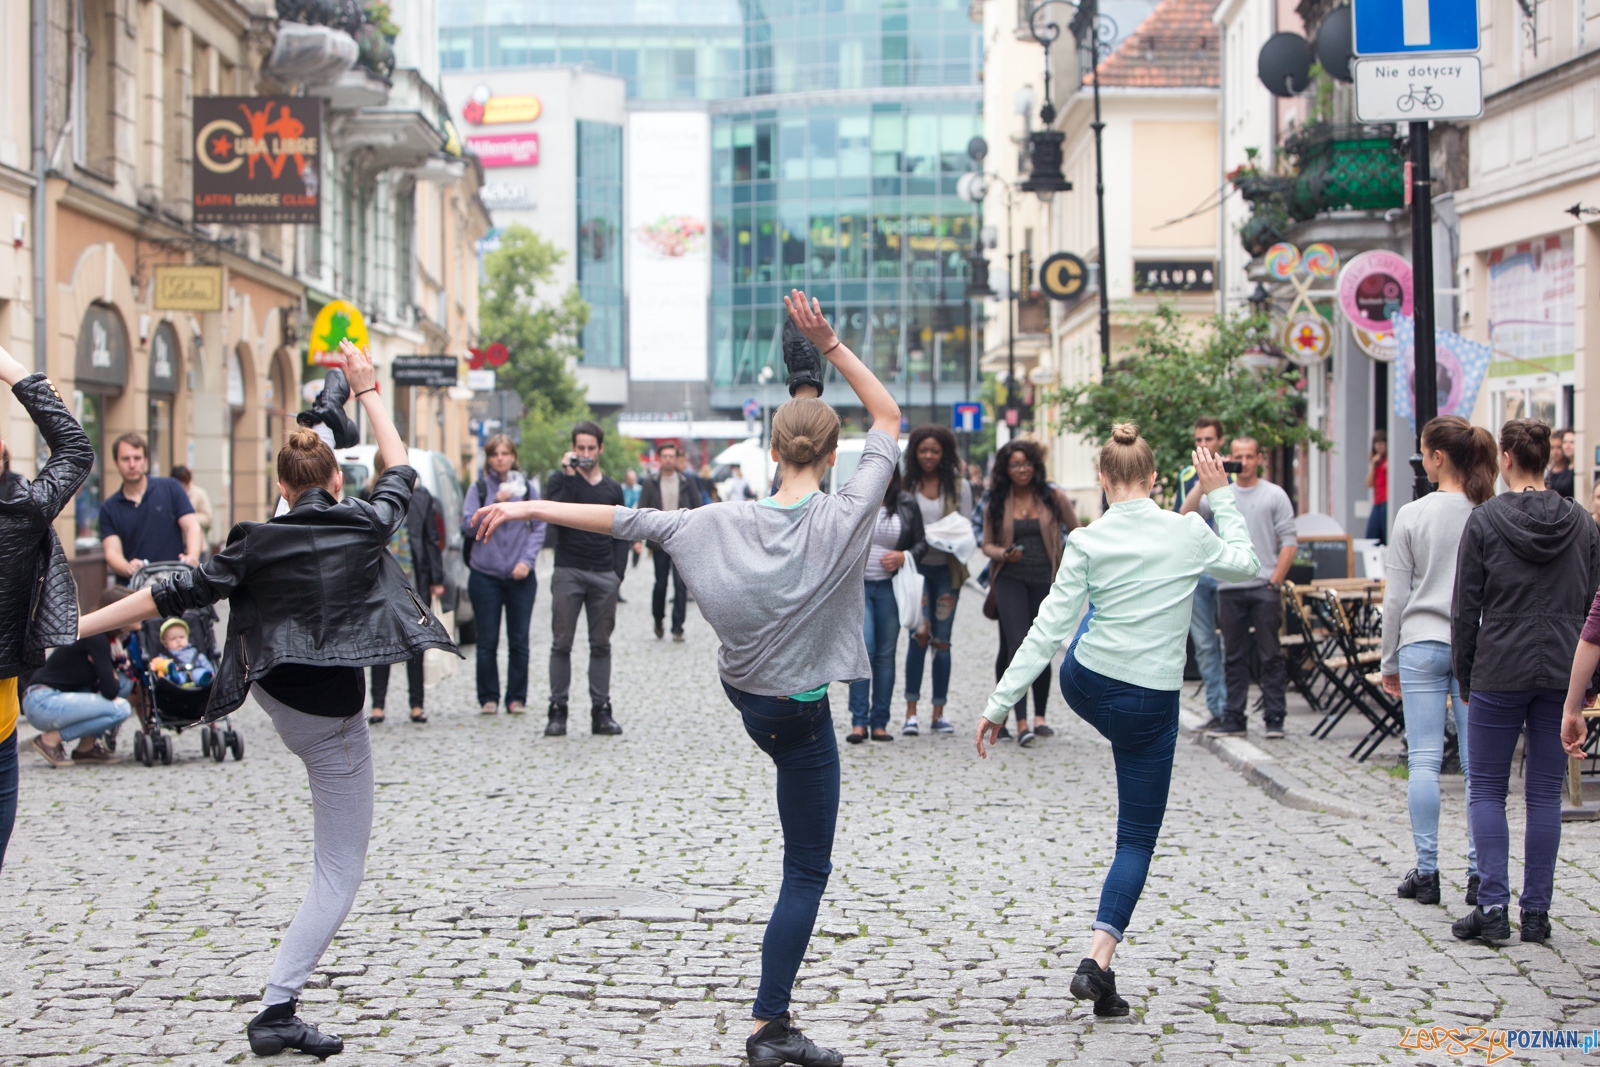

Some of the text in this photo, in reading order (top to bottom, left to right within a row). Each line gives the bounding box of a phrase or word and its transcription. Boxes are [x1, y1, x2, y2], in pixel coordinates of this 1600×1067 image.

[1375, 65, 1462, 79] Nie dotyczy
[272, 137, 318, 156] LIBRE
[195, 193, 317, 207] LATIN DANCE CLUB
[1045, 258, 1083, 296] C
[1147, 269, 1198, 284] KLUB
